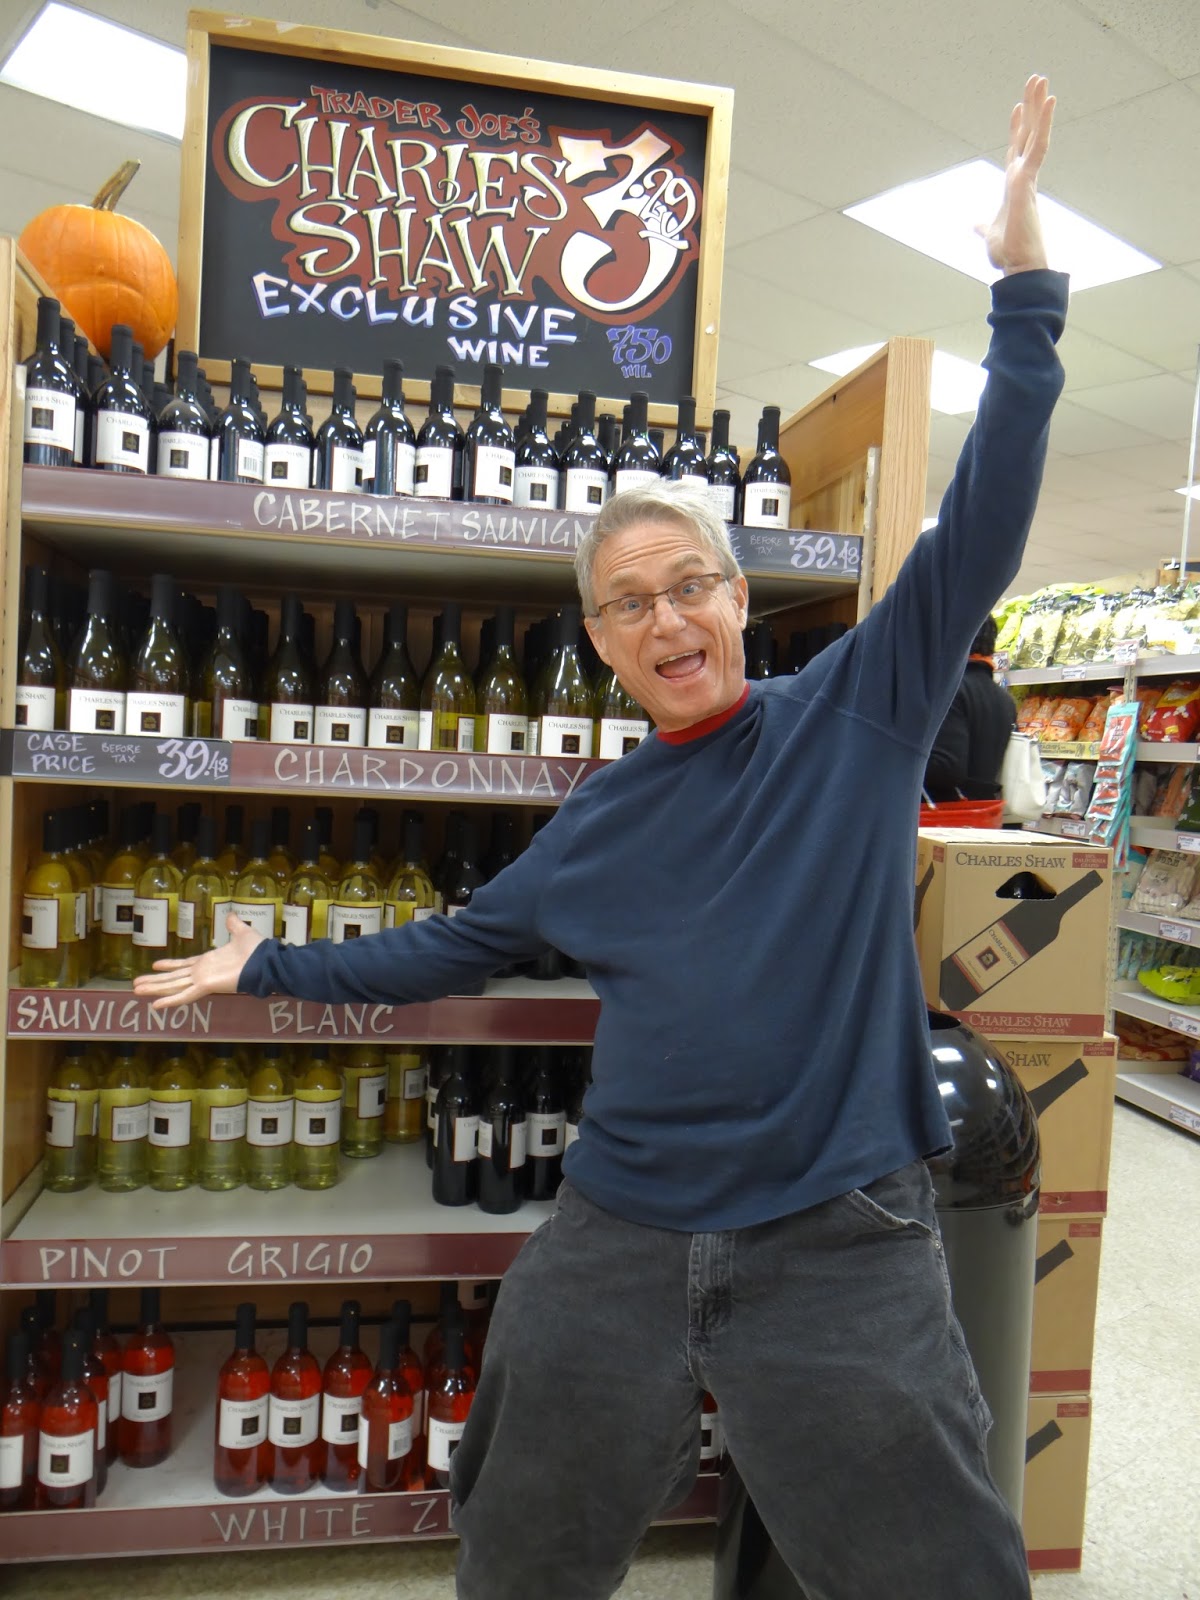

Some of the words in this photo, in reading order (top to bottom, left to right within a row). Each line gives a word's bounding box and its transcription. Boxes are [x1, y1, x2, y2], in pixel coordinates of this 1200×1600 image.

[311, 86, 450, 134] TRADER
[227, 102, 569, 221] CHARLES
[289, 201, 550, 297] SHAW
[251, 272, 578, 344] EXCLUSIVE
[447, 336, 550, 367] WINE
[606, 325, 672, 364] 750
[254, 492, 450, 540] CABERNET
[750, 534, 782, 546] BEFORE
[755, 546, 773, 556] TAX
[27, 733, 87, 752] CASE
[608, 724, 638, 733] CHARLES
[30, 754, 96, 773] PRICE
[101, 742, 141, 754] BEFORE
[156, 738, 229, 781] 39.48
[112, 753, 136, 764] TAX
[274, 748, 588, 799] CHARDONNAY
[955, 852, 1022, 868] CHARLES
[16, 995, 212, 1033] SAUVIGNON
[268, 1000, 394, 1036] BLANC
[969, 1013, 1032, 1028] CHARLES
[39, 1246, 177, 1280] PINOT
[228, 1241, 374, 1279] GRIGIO
[210, 1503, 375, 1542] WHITE
